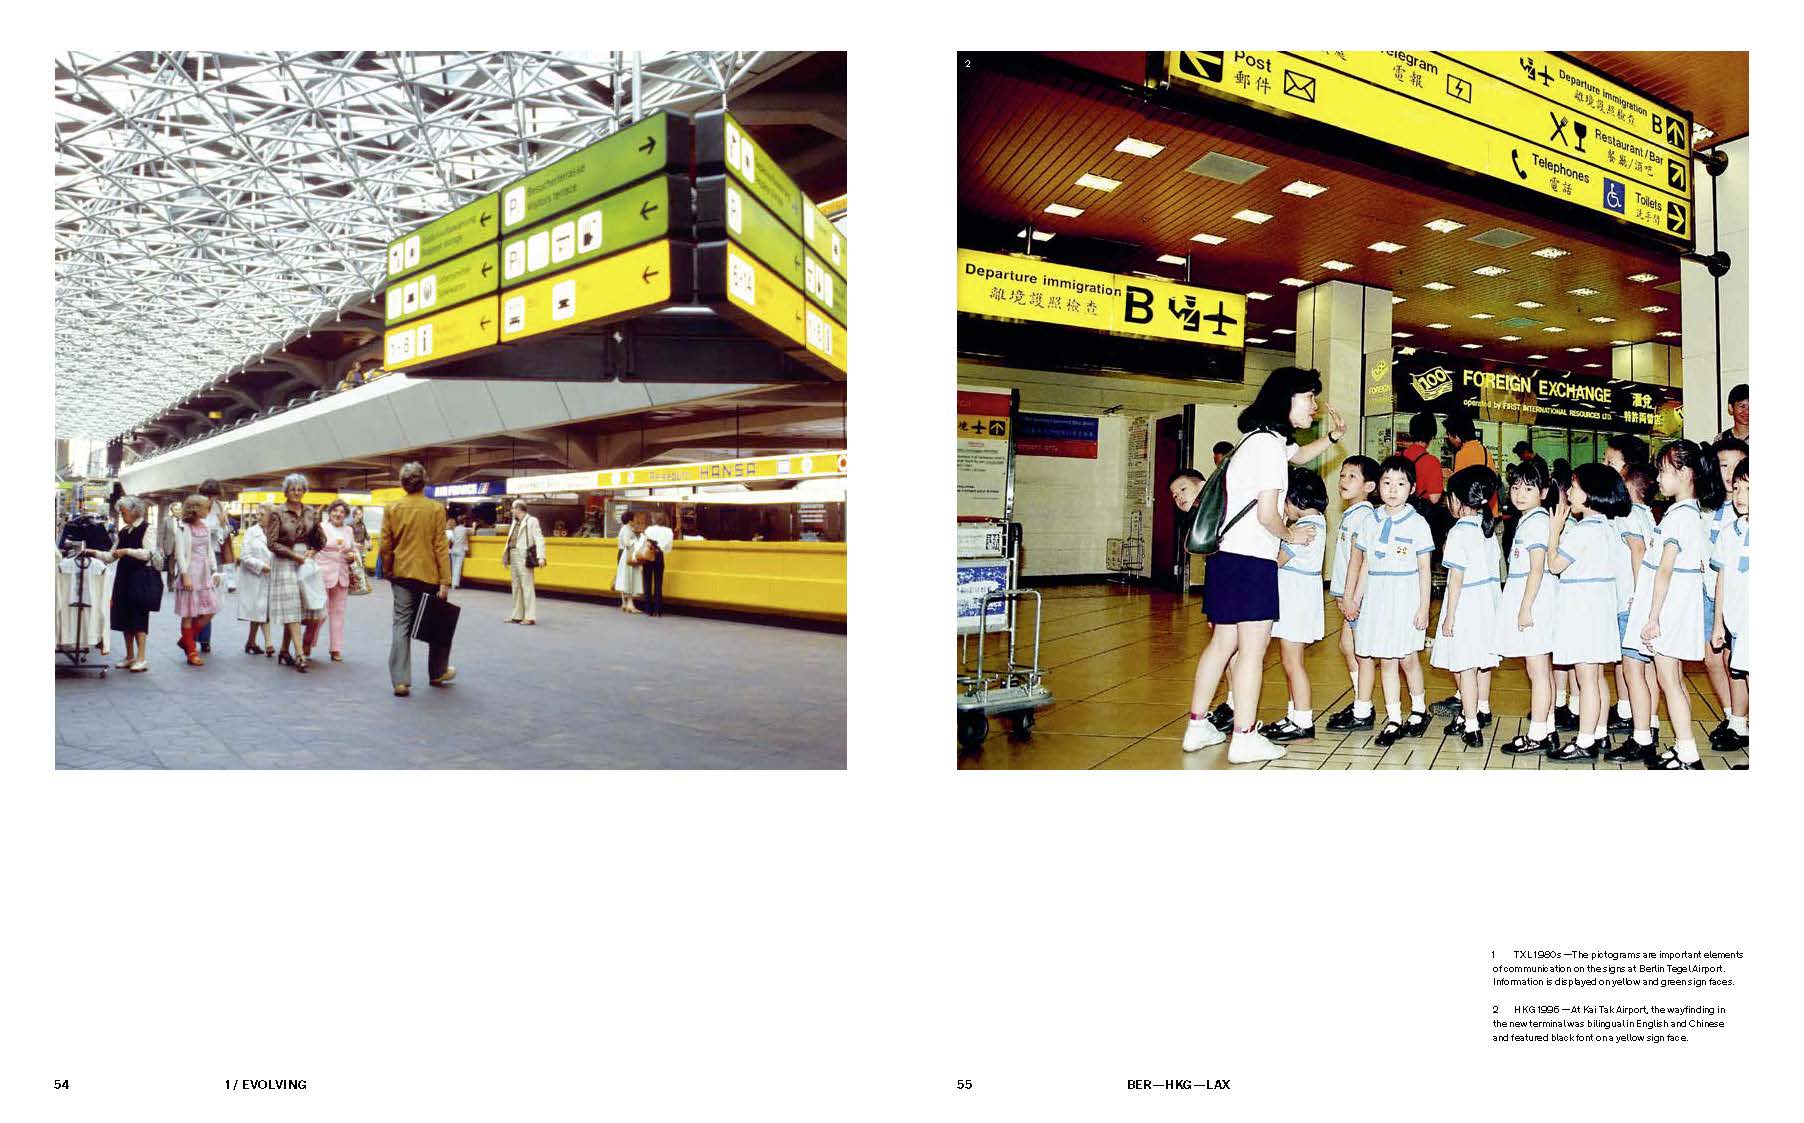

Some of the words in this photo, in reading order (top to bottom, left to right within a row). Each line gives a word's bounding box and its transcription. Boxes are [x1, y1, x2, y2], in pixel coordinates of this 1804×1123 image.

[1234, 51, 1272, 73] Post
[1381, 51, 1438, 75] elegram
[1234, 71, 1271, 95] 郵件
[1393, 65, 1423, 88] 電報
[1559, 69, 1600, 95] Departure
[1602, 88, 1648, 117] immigration
[1652, 113, 1662, 134] B
[1532, 153, 1590, 183] Telephones
[1550, 177, 1573, 196] 電話
[1635, 192, 1662, 211] Toilets
[965, 263, 1037, 284] Departure
[1043, 275, 1122, 297] immigration
[1124, 285, 1154, 324] B
[990, 287, 1097, 316] 離境護照檢查
[1418, 369, 1447, 391] 100
[1463, 369, 1531, 393] FOREIGN
[1539, 380, 1612, 403] EXCHANGE
[1463, 399, 1492, 408] operated
[1493, 401, 1501, 410] by
[1502, 403, 1520, 411] FIRST
[1523, 404, 1567, 416] INTERNATIONAL
[1569, 409, 1600, 420] RESOURCES
[700, 463, 756, 480] HANSA
